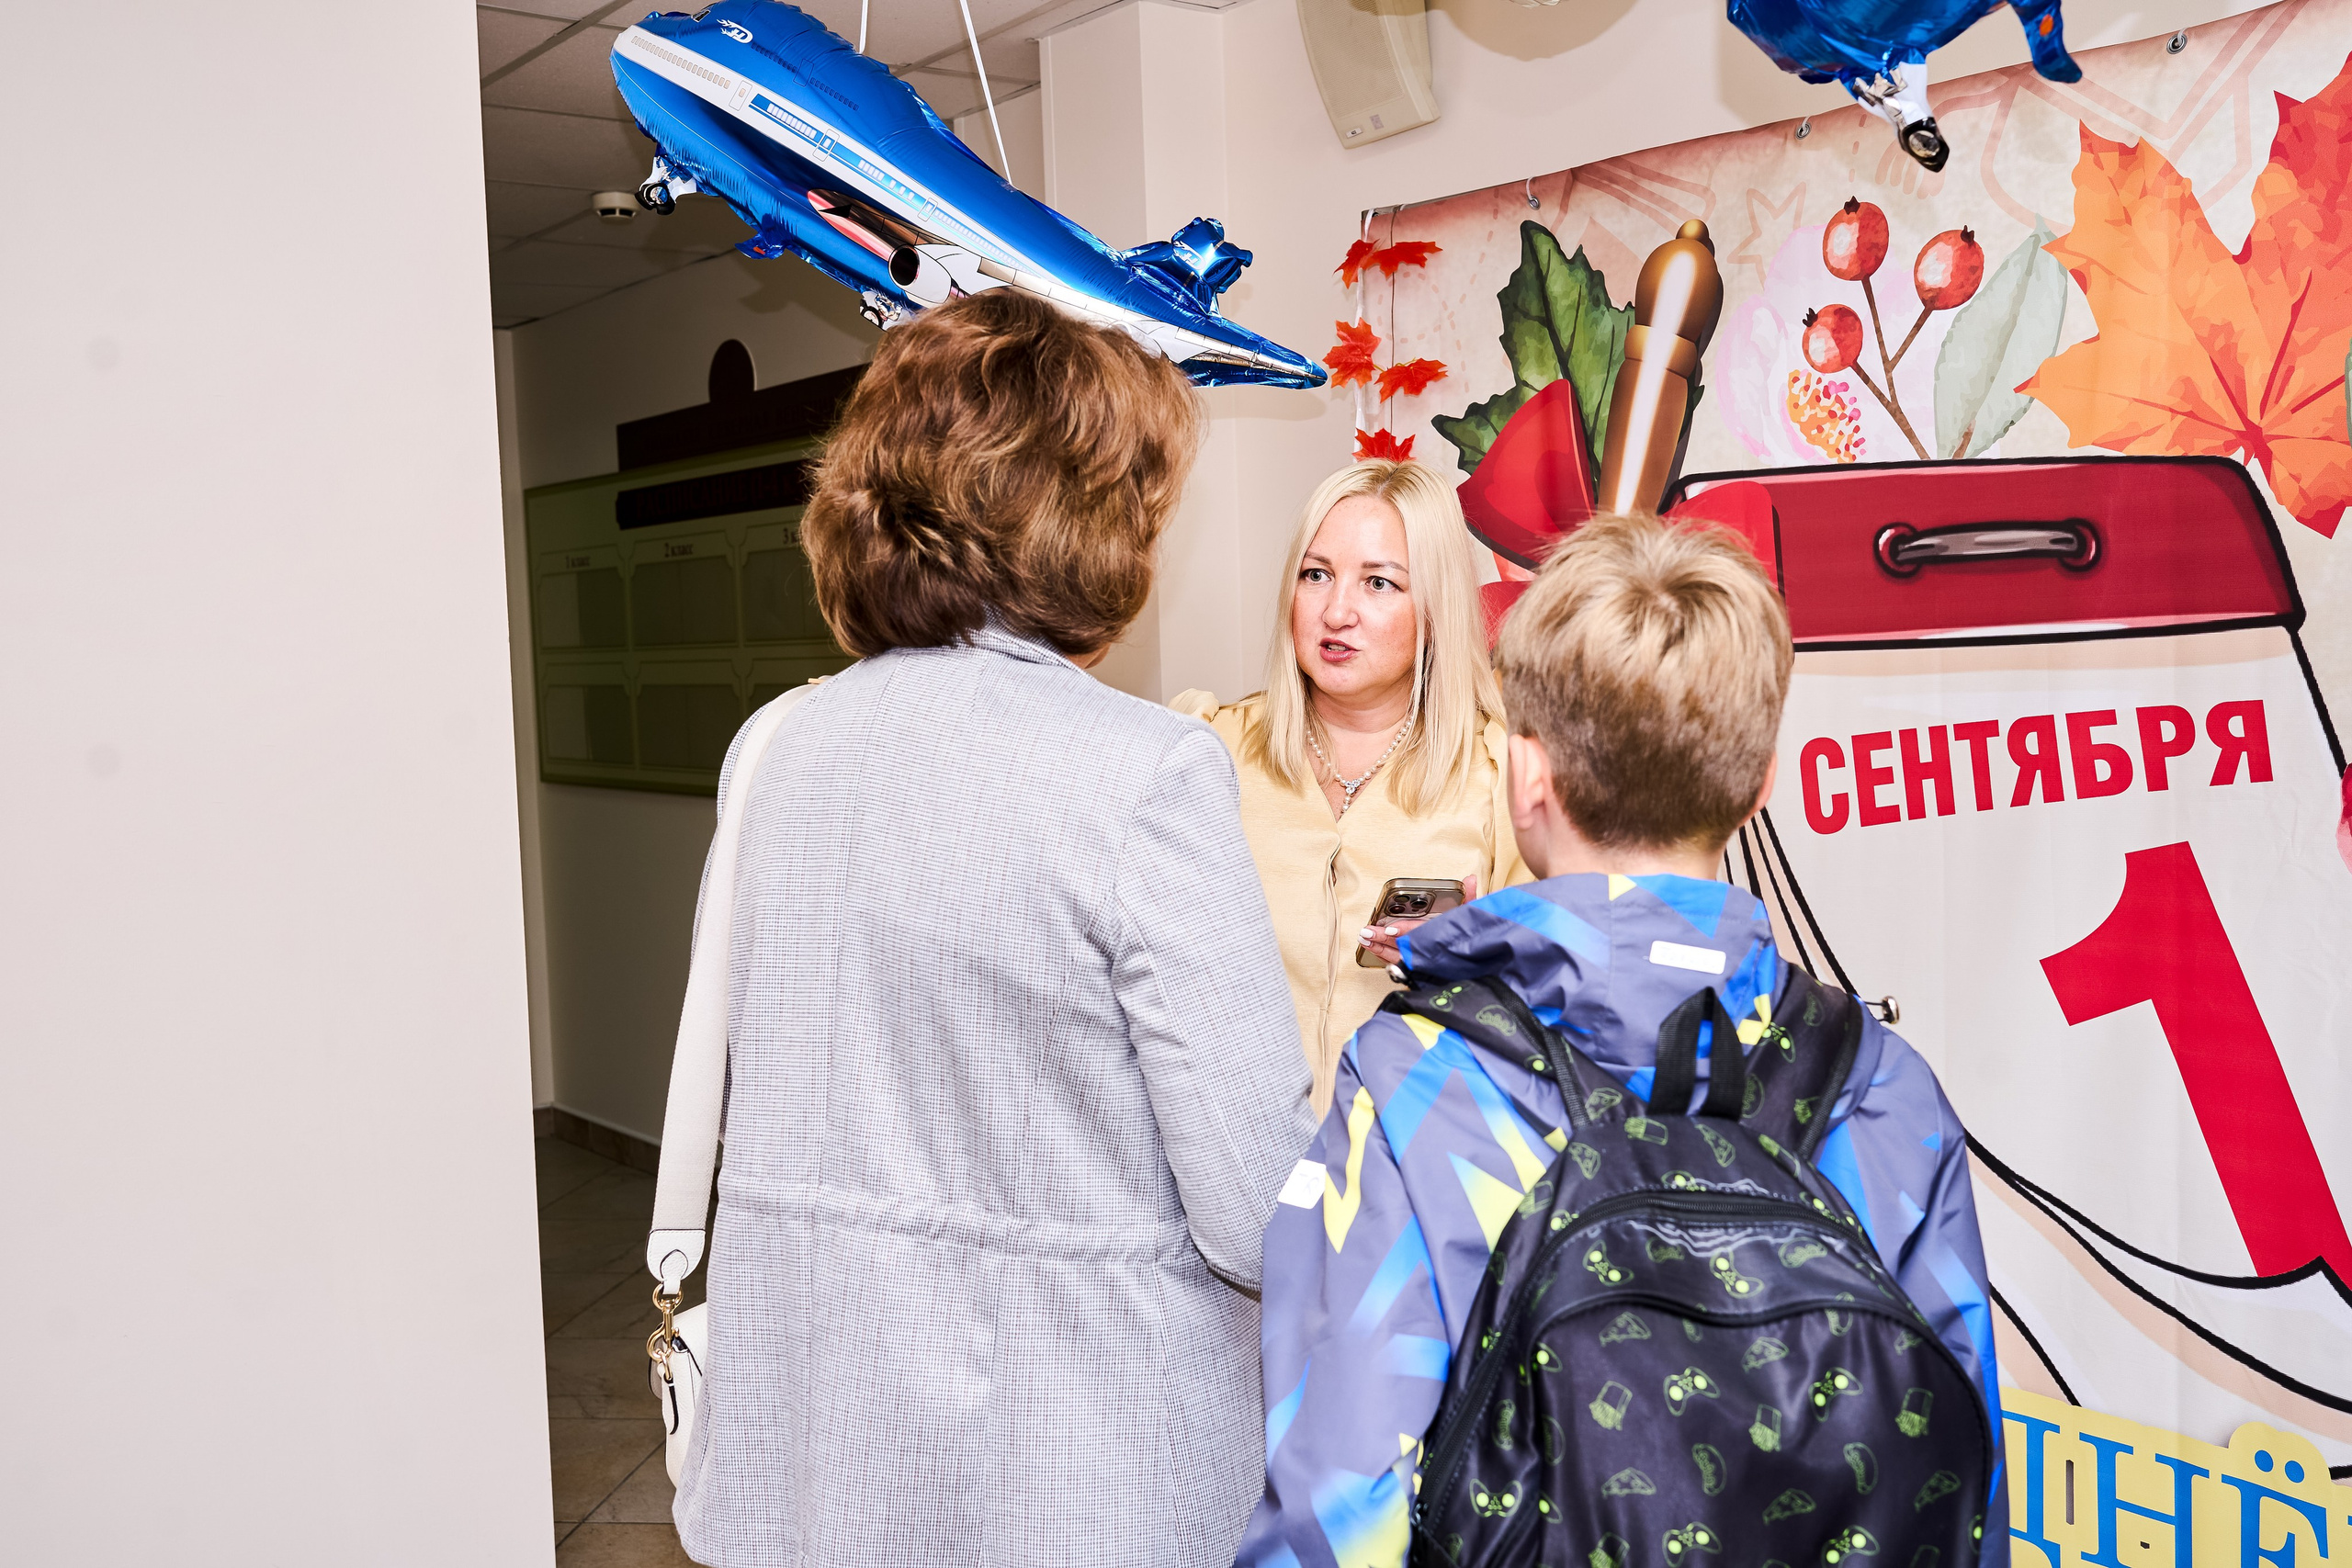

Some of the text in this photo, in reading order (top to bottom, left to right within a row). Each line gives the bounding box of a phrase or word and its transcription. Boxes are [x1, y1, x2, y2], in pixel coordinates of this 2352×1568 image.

[664, 543, 670, 558] 2
[1800, 699, 2273, 835] СЕНТЯБРЯ
[2040, 841, 2352, 1292] 1
